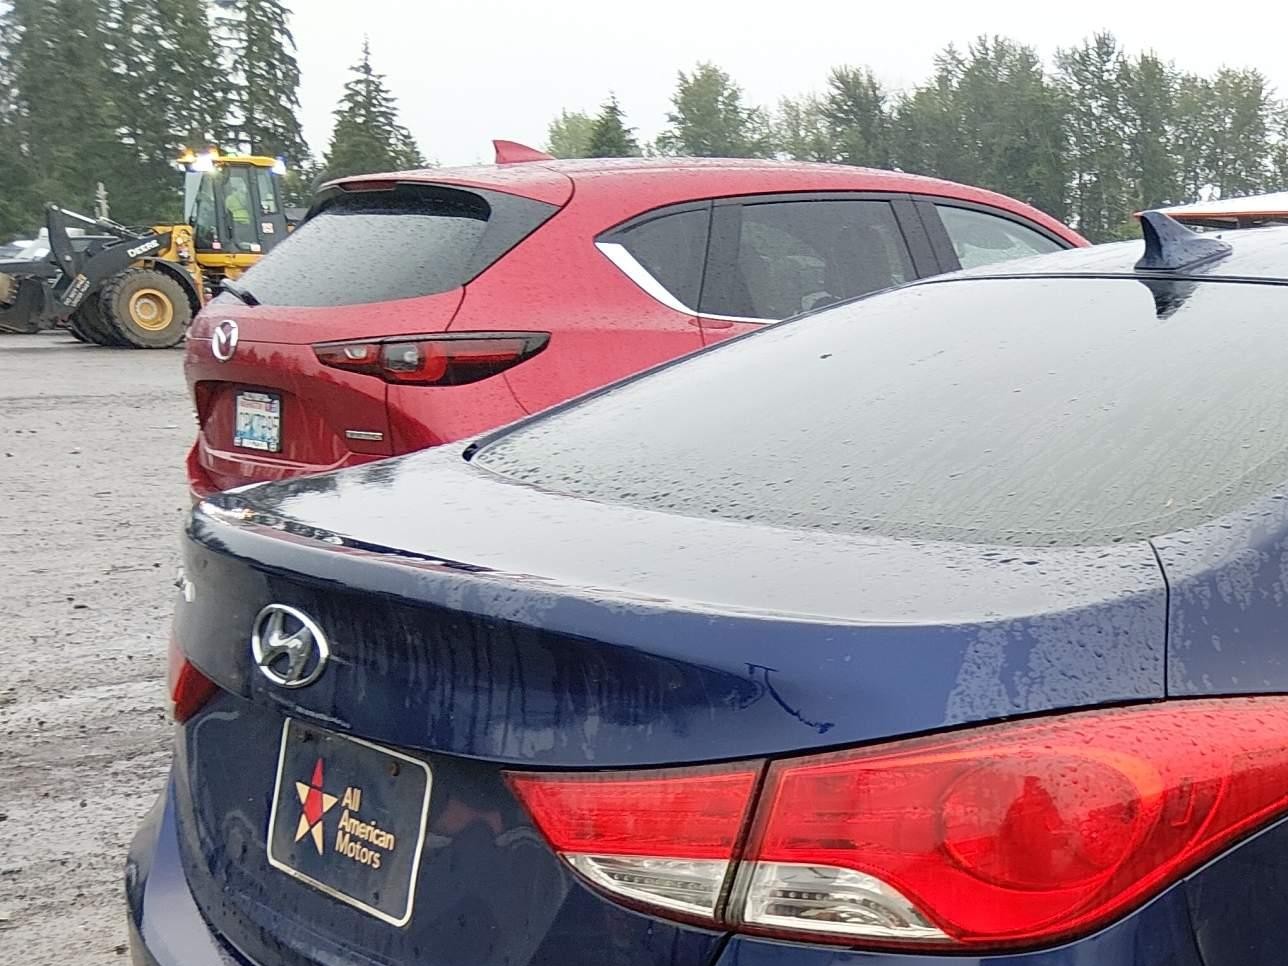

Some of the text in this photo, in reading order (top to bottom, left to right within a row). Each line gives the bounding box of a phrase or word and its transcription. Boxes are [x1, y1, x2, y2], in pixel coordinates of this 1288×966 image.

[126, 239, 160, 258] DEERE
[341, 787, 362, 812] All
[338, 809, 396, 850] American
[335, 831, 381, 869] Motors
